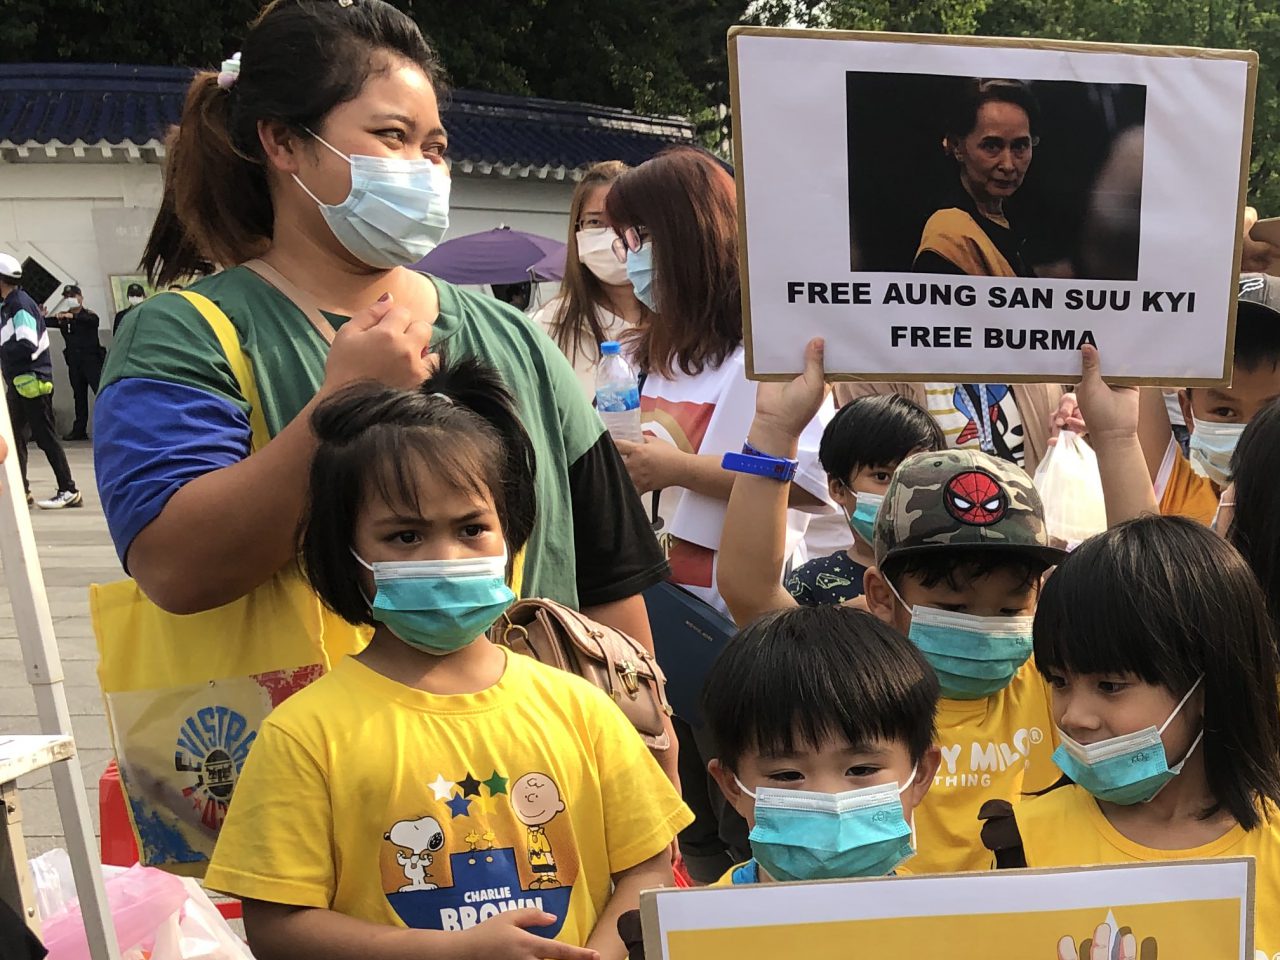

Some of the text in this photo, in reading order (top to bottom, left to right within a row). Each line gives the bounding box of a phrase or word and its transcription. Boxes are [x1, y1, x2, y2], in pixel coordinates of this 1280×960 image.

[787, 281, 1196, 314] FREE AUNG SAN SUU KYI
[890, 325, 1099, 351] FREE BURMA
[463, 886, 512, 904] CHARLIE
